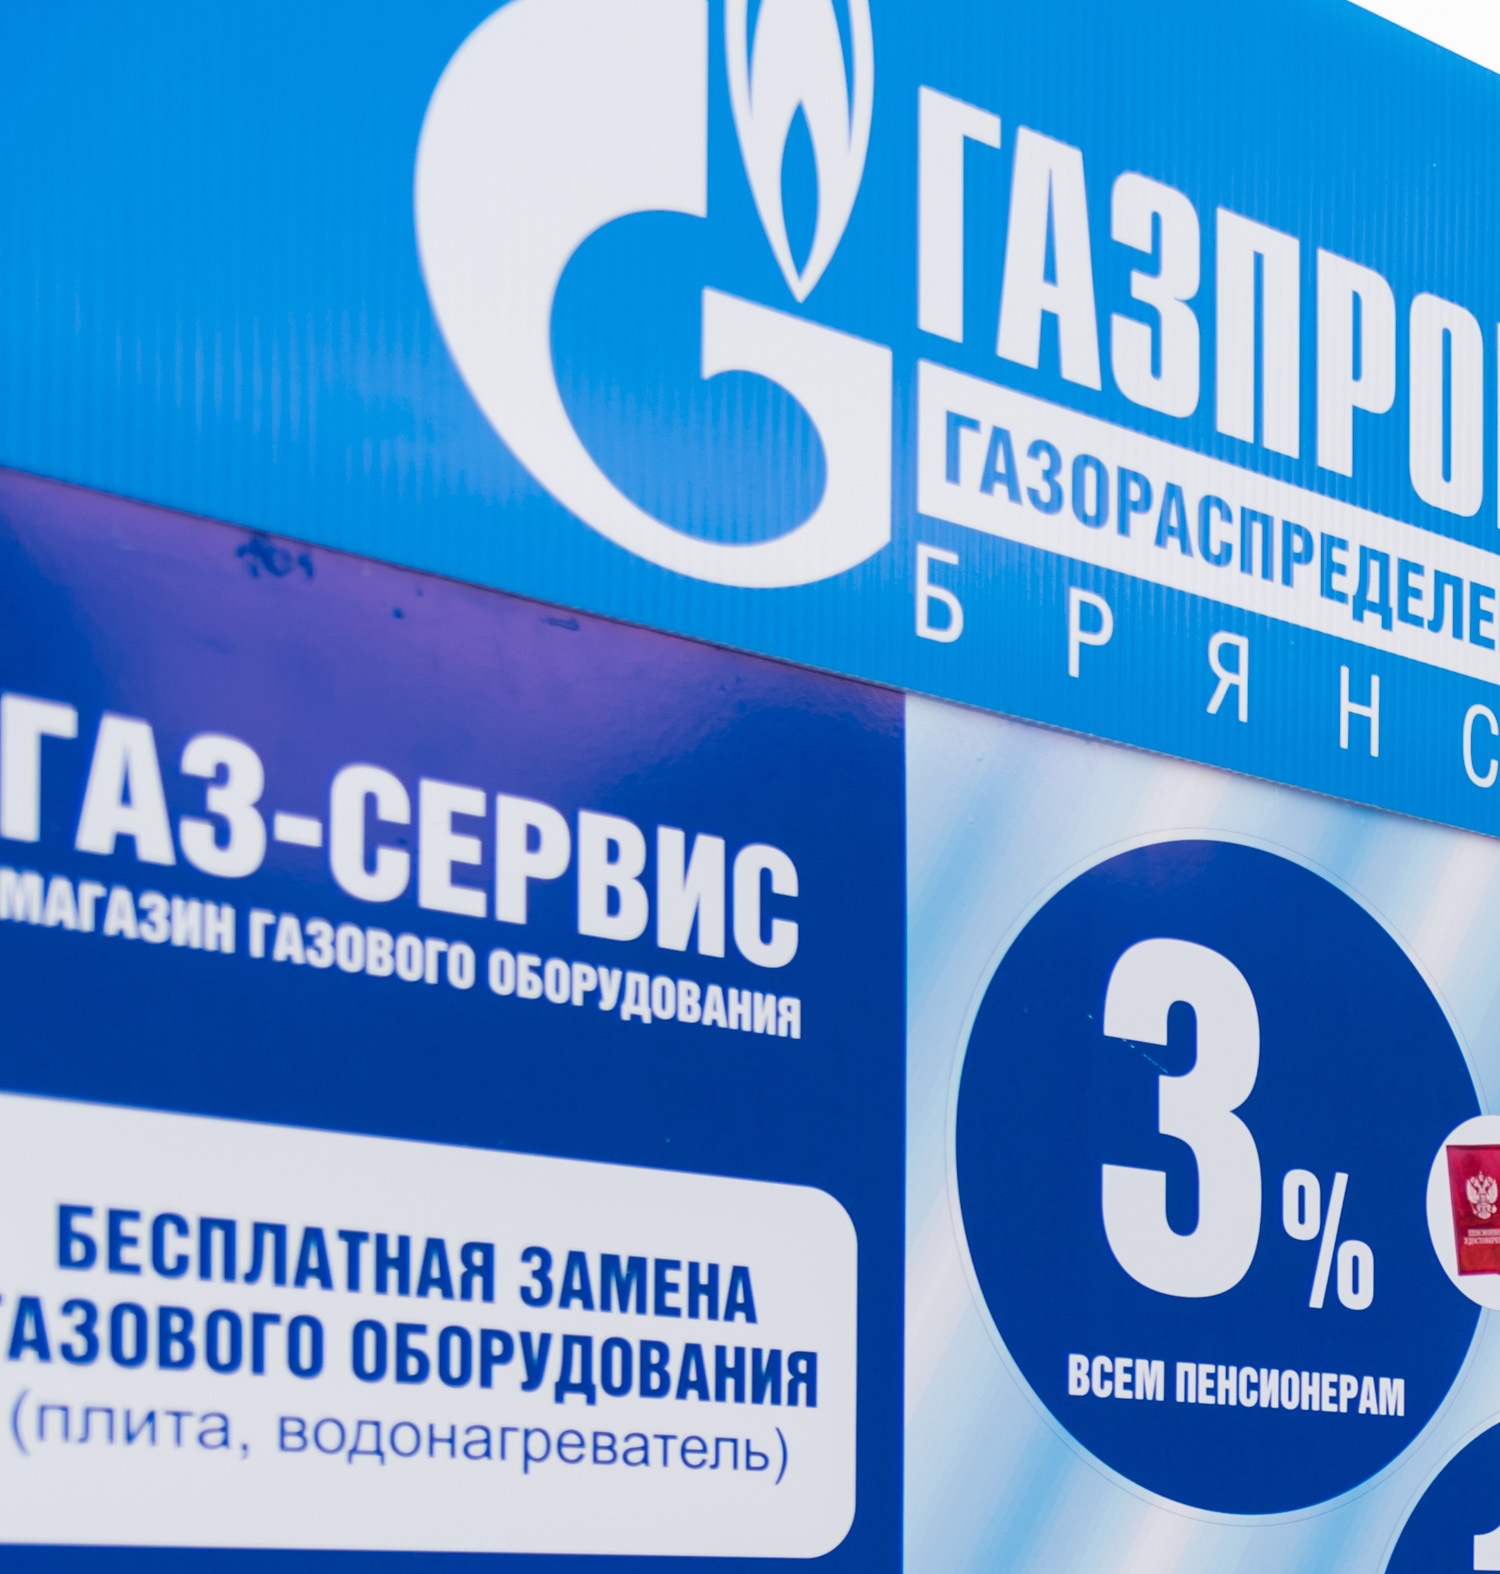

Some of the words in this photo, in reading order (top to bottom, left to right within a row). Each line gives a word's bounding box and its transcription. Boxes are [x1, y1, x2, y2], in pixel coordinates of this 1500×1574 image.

[0, 691, 800, 969] ГАЗ-СЕРВИС
[0, 866, 237, 954] МАГАЗИН
[249, 910, 476, 990] ГАЗОВОГО
[489, 949, 802, 1039] ОБОРУДОВАНИЯ
[56, 1203, 497, 1304] БЕСПЛАТНАЯ
[519, 1245, 759, 1324] ЗАМЕНА
[0, 1293, 325, 1379] АЗОВОГО
[351, 1318, 819, 1408] ОБОРУДОВАНИЯ
[1067, 1353, 1165, 1403] ВСЕМ
[1175, 1361, 1406, 1417] ПЕНСИОНЕРАМ
[11, 1387, 251, 1460] (плита,
[278, 1413, 790, 1486] водонагреватель)
